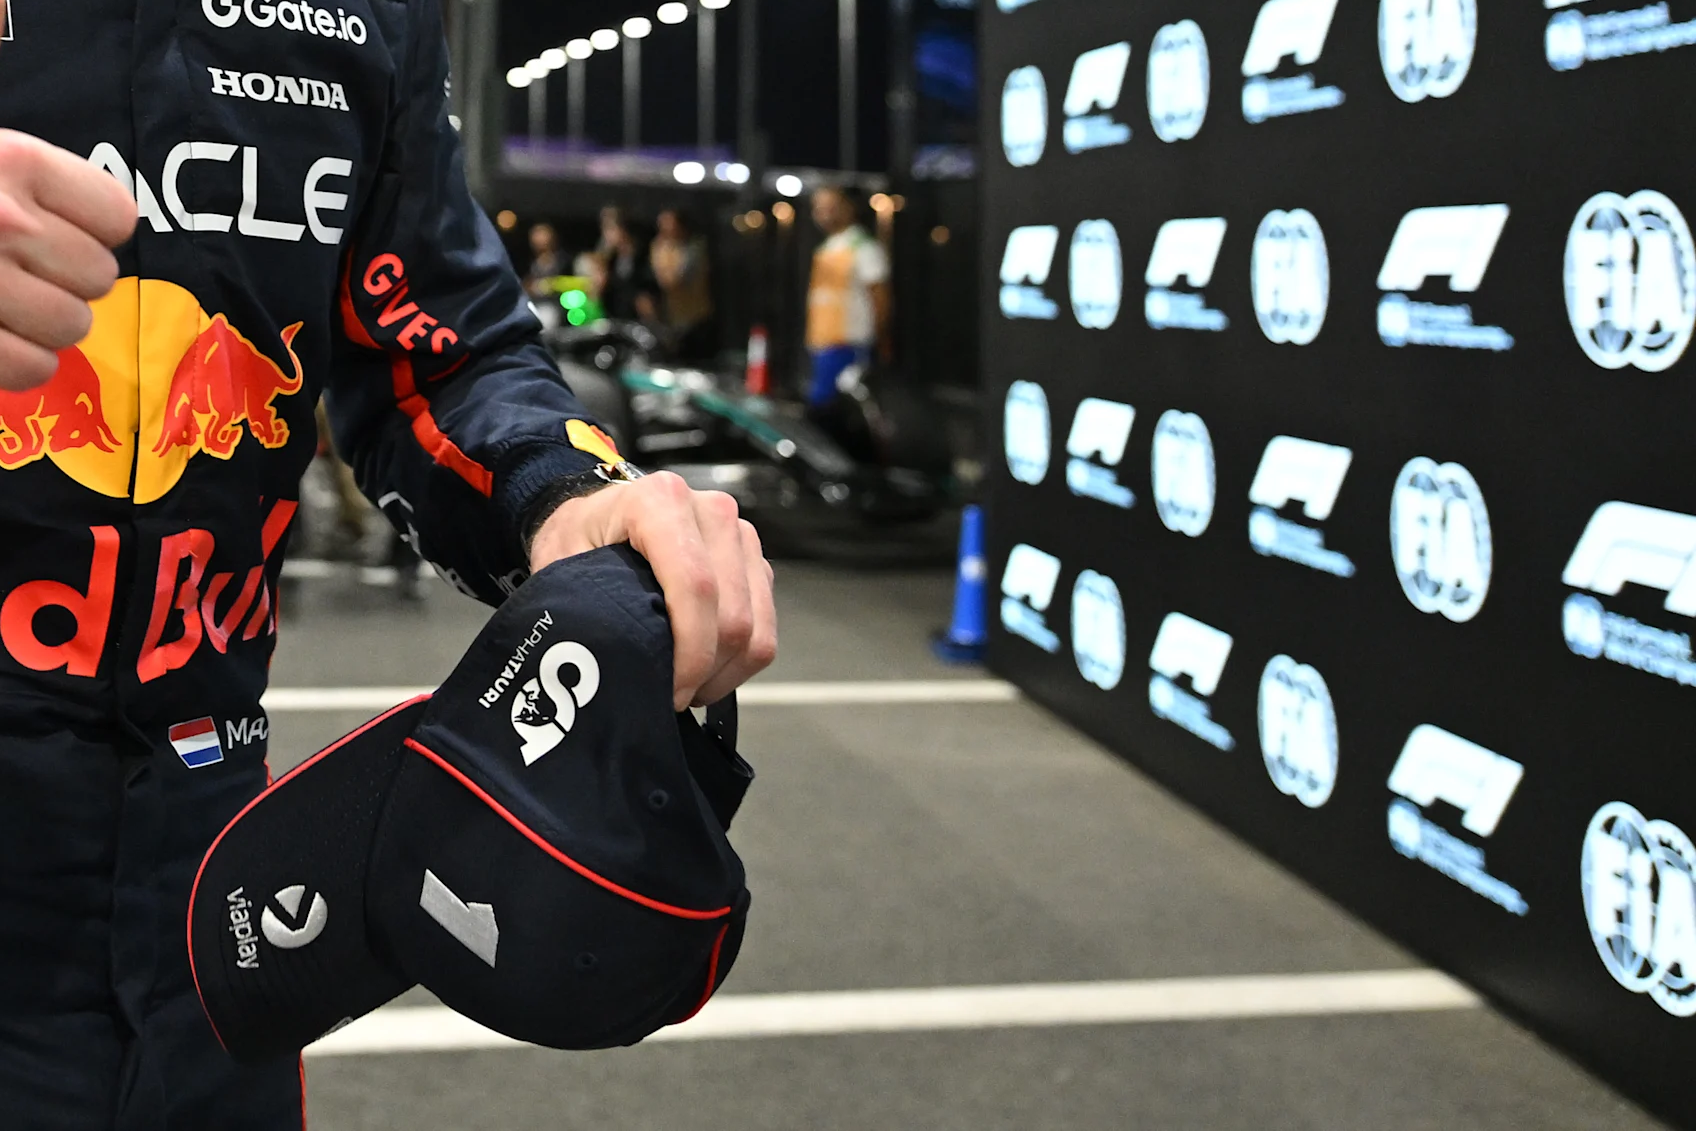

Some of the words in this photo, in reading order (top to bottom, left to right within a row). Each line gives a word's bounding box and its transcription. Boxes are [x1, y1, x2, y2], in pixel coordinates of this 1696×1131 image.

[207, 66, 350, 112] HONDA
[477, 609, 554, 709] ALPHATAURI
[225, 716, 268, 750] MA
[226, 886, 260, 971] viaplay
